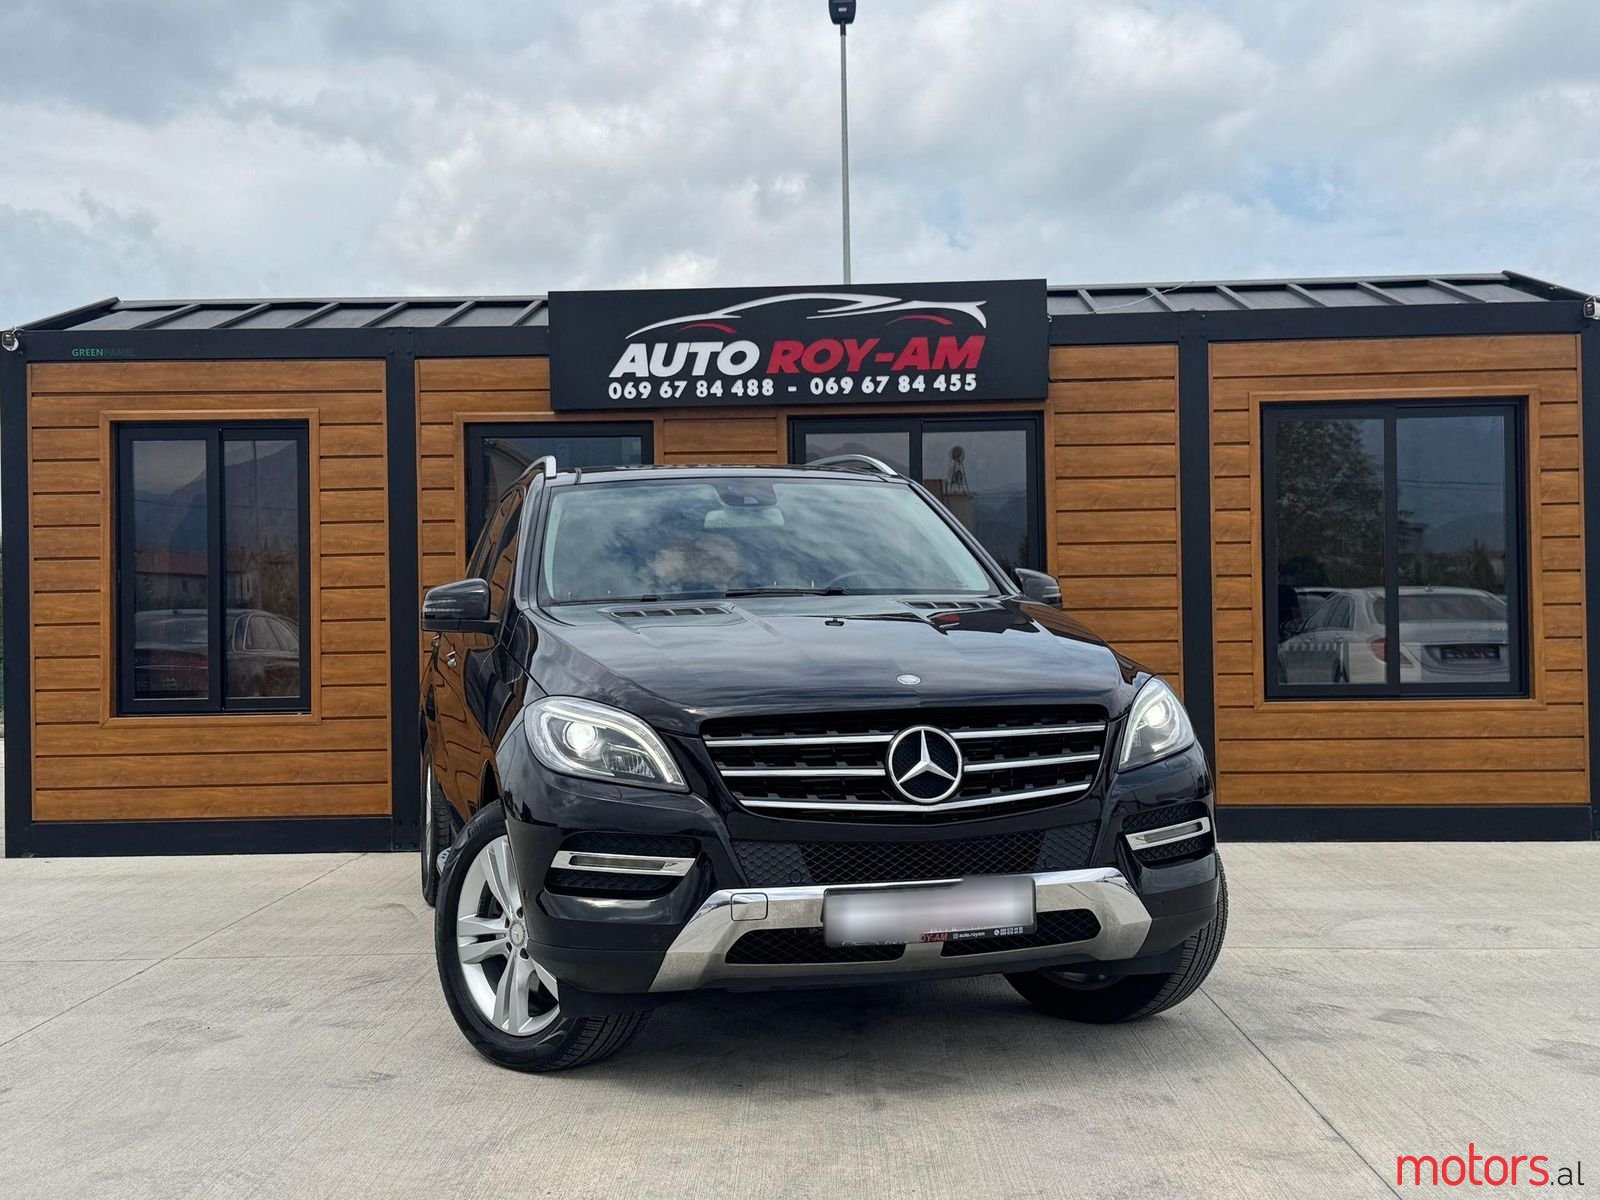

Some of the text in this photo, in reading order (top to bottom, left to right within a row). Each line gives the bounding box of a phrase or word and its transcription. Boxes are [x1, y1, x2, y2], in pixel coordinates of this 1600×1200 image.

[608, 335, 985, 378] AUTO ROY-AM
[608, 381, 652, 400] 069
[659, 380, 688, 399] 67
[695, 379, 724, 398] 84
[730, 378, 774, 397] 488
[809, 376, 855, 396] 069
[861, 375, 890, 394] 67
[897, 374, 926, 393] 84
[932, 373, 977, 393] 455
